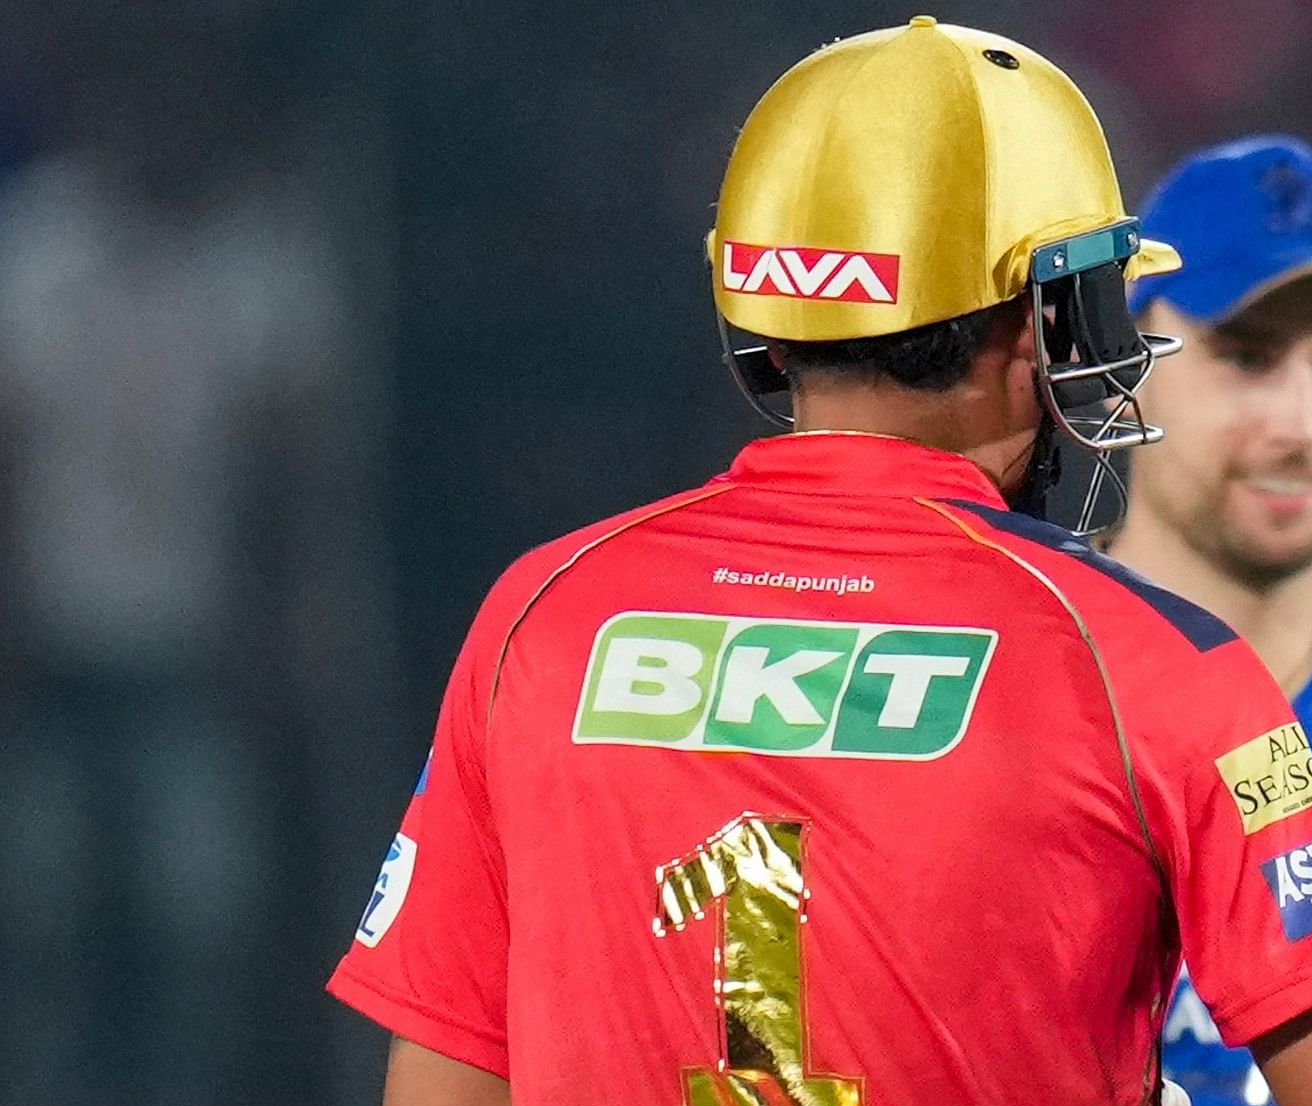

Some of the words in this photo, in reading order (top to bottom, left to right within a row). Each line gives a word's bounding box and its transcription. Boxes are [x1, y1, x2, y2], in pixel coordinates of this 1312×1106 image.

[723, 243, 896, 302] LAVA
[712, 566, 875, 596] #saddapunjab
[592, 637, 970, 730] BKT
